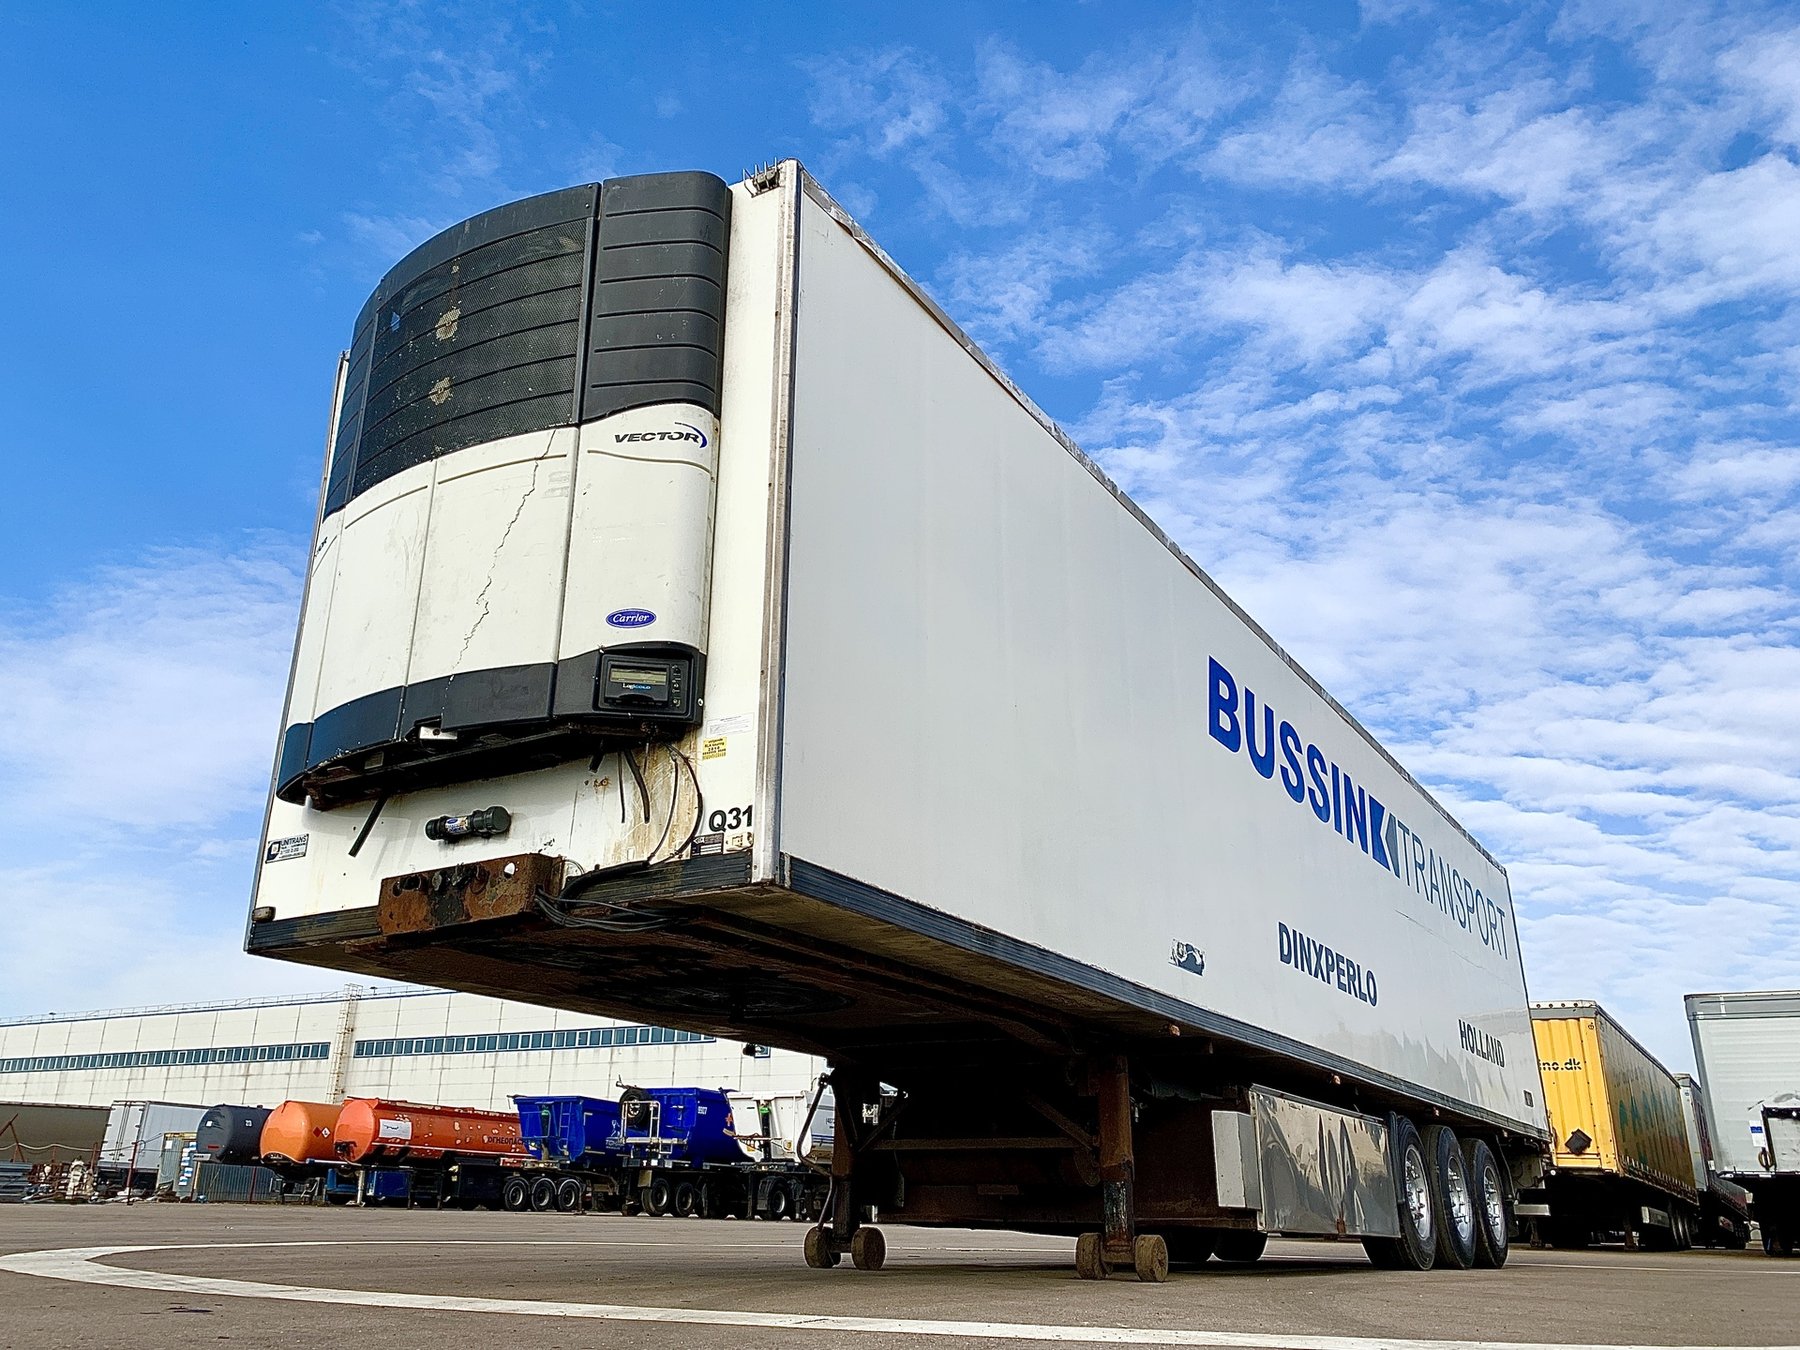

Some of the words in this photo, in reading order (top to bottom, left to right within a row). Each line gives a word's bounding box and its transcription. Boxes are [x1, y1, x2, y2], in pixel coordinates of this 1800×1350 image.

[614, 431, 700, 444] VECTOR
[612, 613, 650, 623] Carrier
[1208, 654, 1394, 874] BUSSINK
[708, 804, 753, 832] Q31
[1397, 819, 1508, 960] TRANSPORT
[1278, 921, 1378, 1007] DINXPERLO
[1458, 1018, 1505, 1068] HOLLAND
[488, 1136, 524, 1145] ОГНЕОПАС
